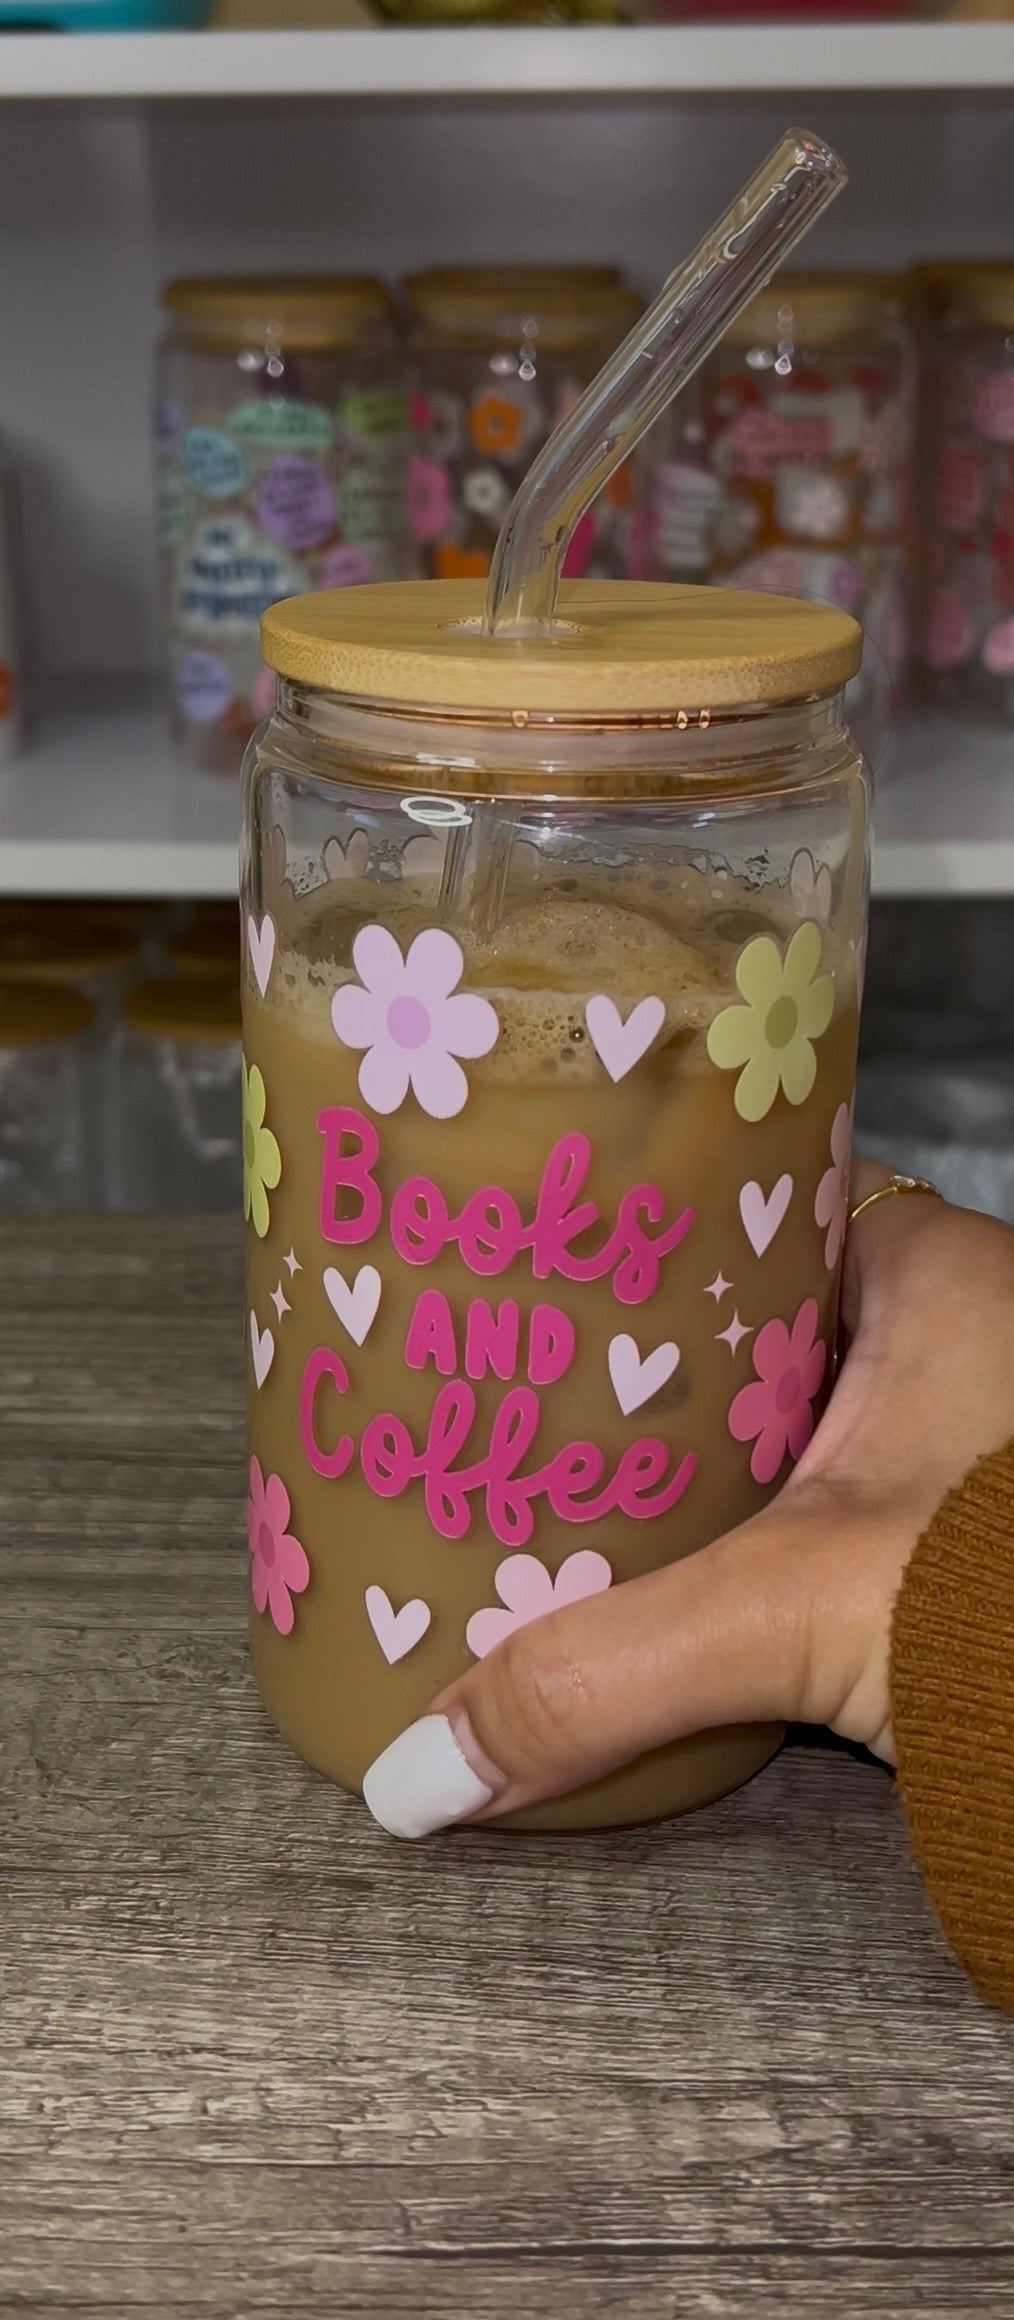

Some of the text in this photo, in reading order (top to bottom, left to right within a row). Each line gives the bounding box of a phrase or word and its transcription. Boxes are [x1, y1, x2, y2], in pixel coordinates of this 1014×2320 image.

[317, 1107, 696, 1304] Books
[405, 1290, 575, 1385] AND
[300, 1347, 697, 1546] Coffee
